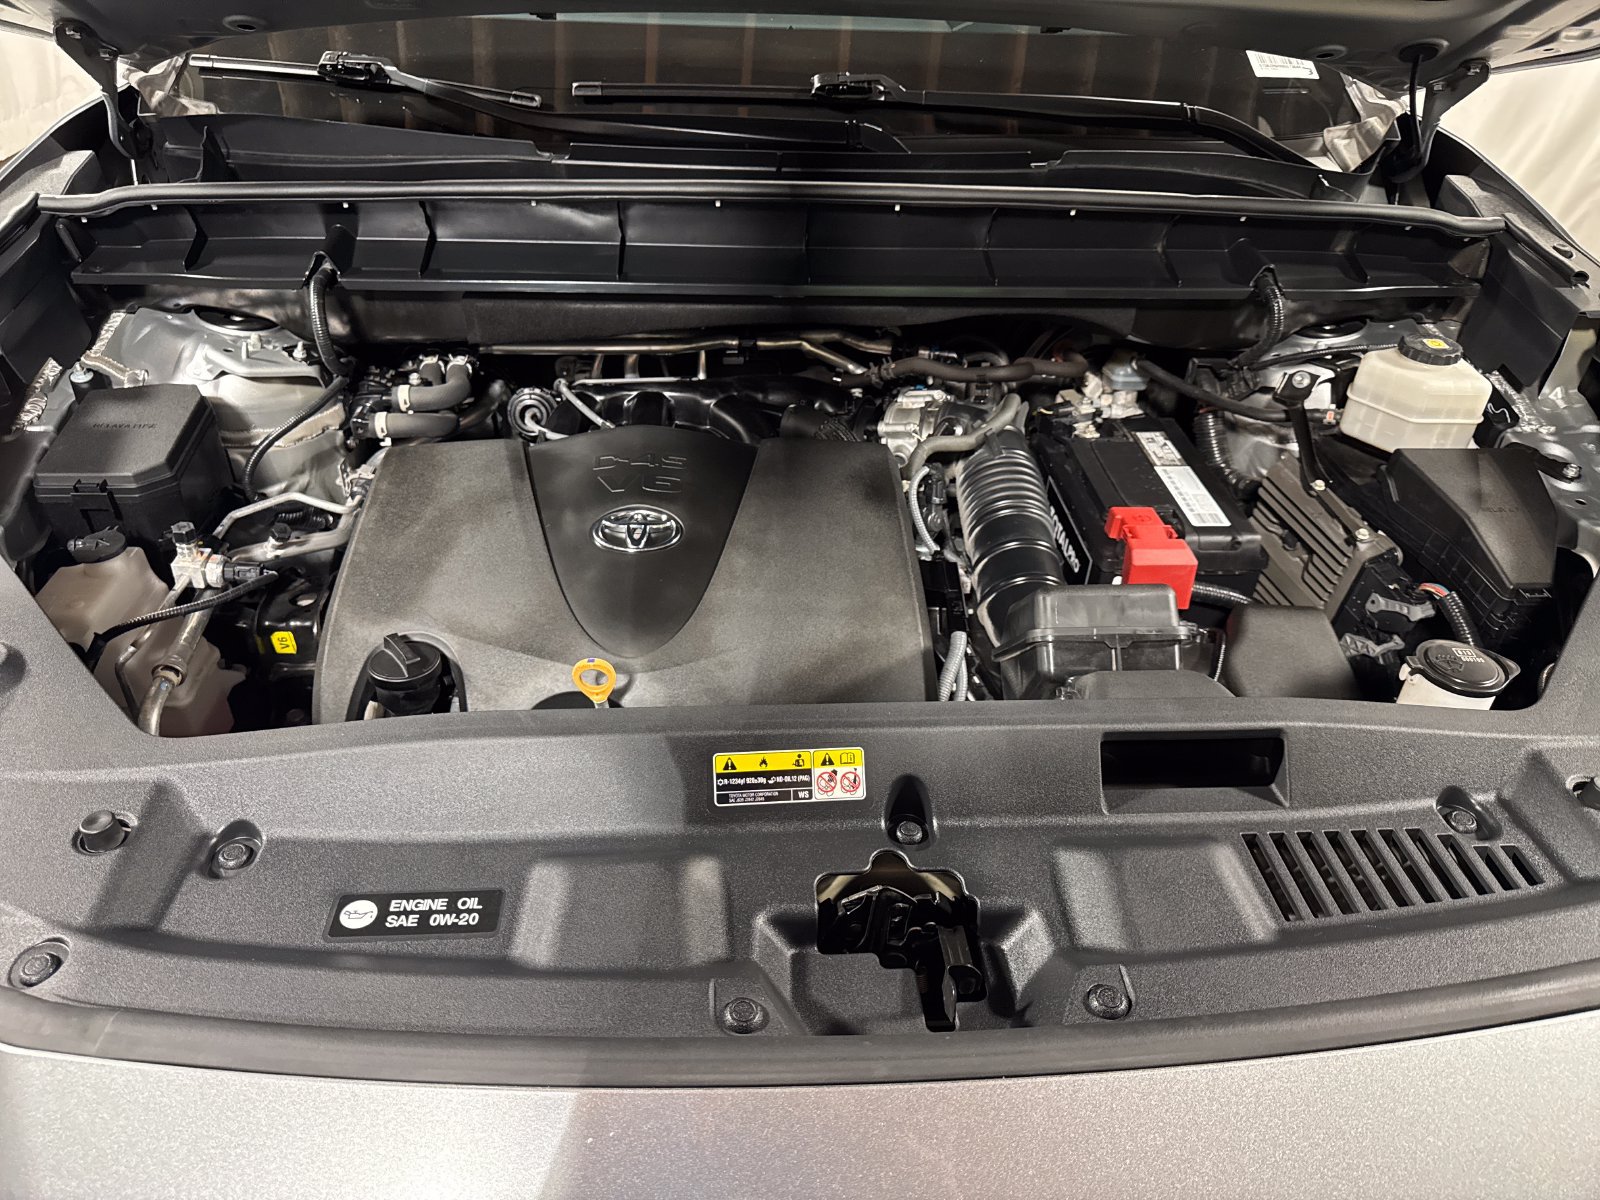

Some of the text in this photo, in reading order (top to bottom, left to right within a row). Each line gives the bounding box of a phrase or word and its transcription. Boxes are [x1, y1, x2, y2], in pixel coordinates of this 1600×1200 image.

[597, 475, 682, 493] V6
[277, 636, 290, 650] V6
[797, 790, 810, 799] WS
[389, 897, 483, 911] ENGINE OIL
[385, 913, 480, 928] SAE 0W-20
